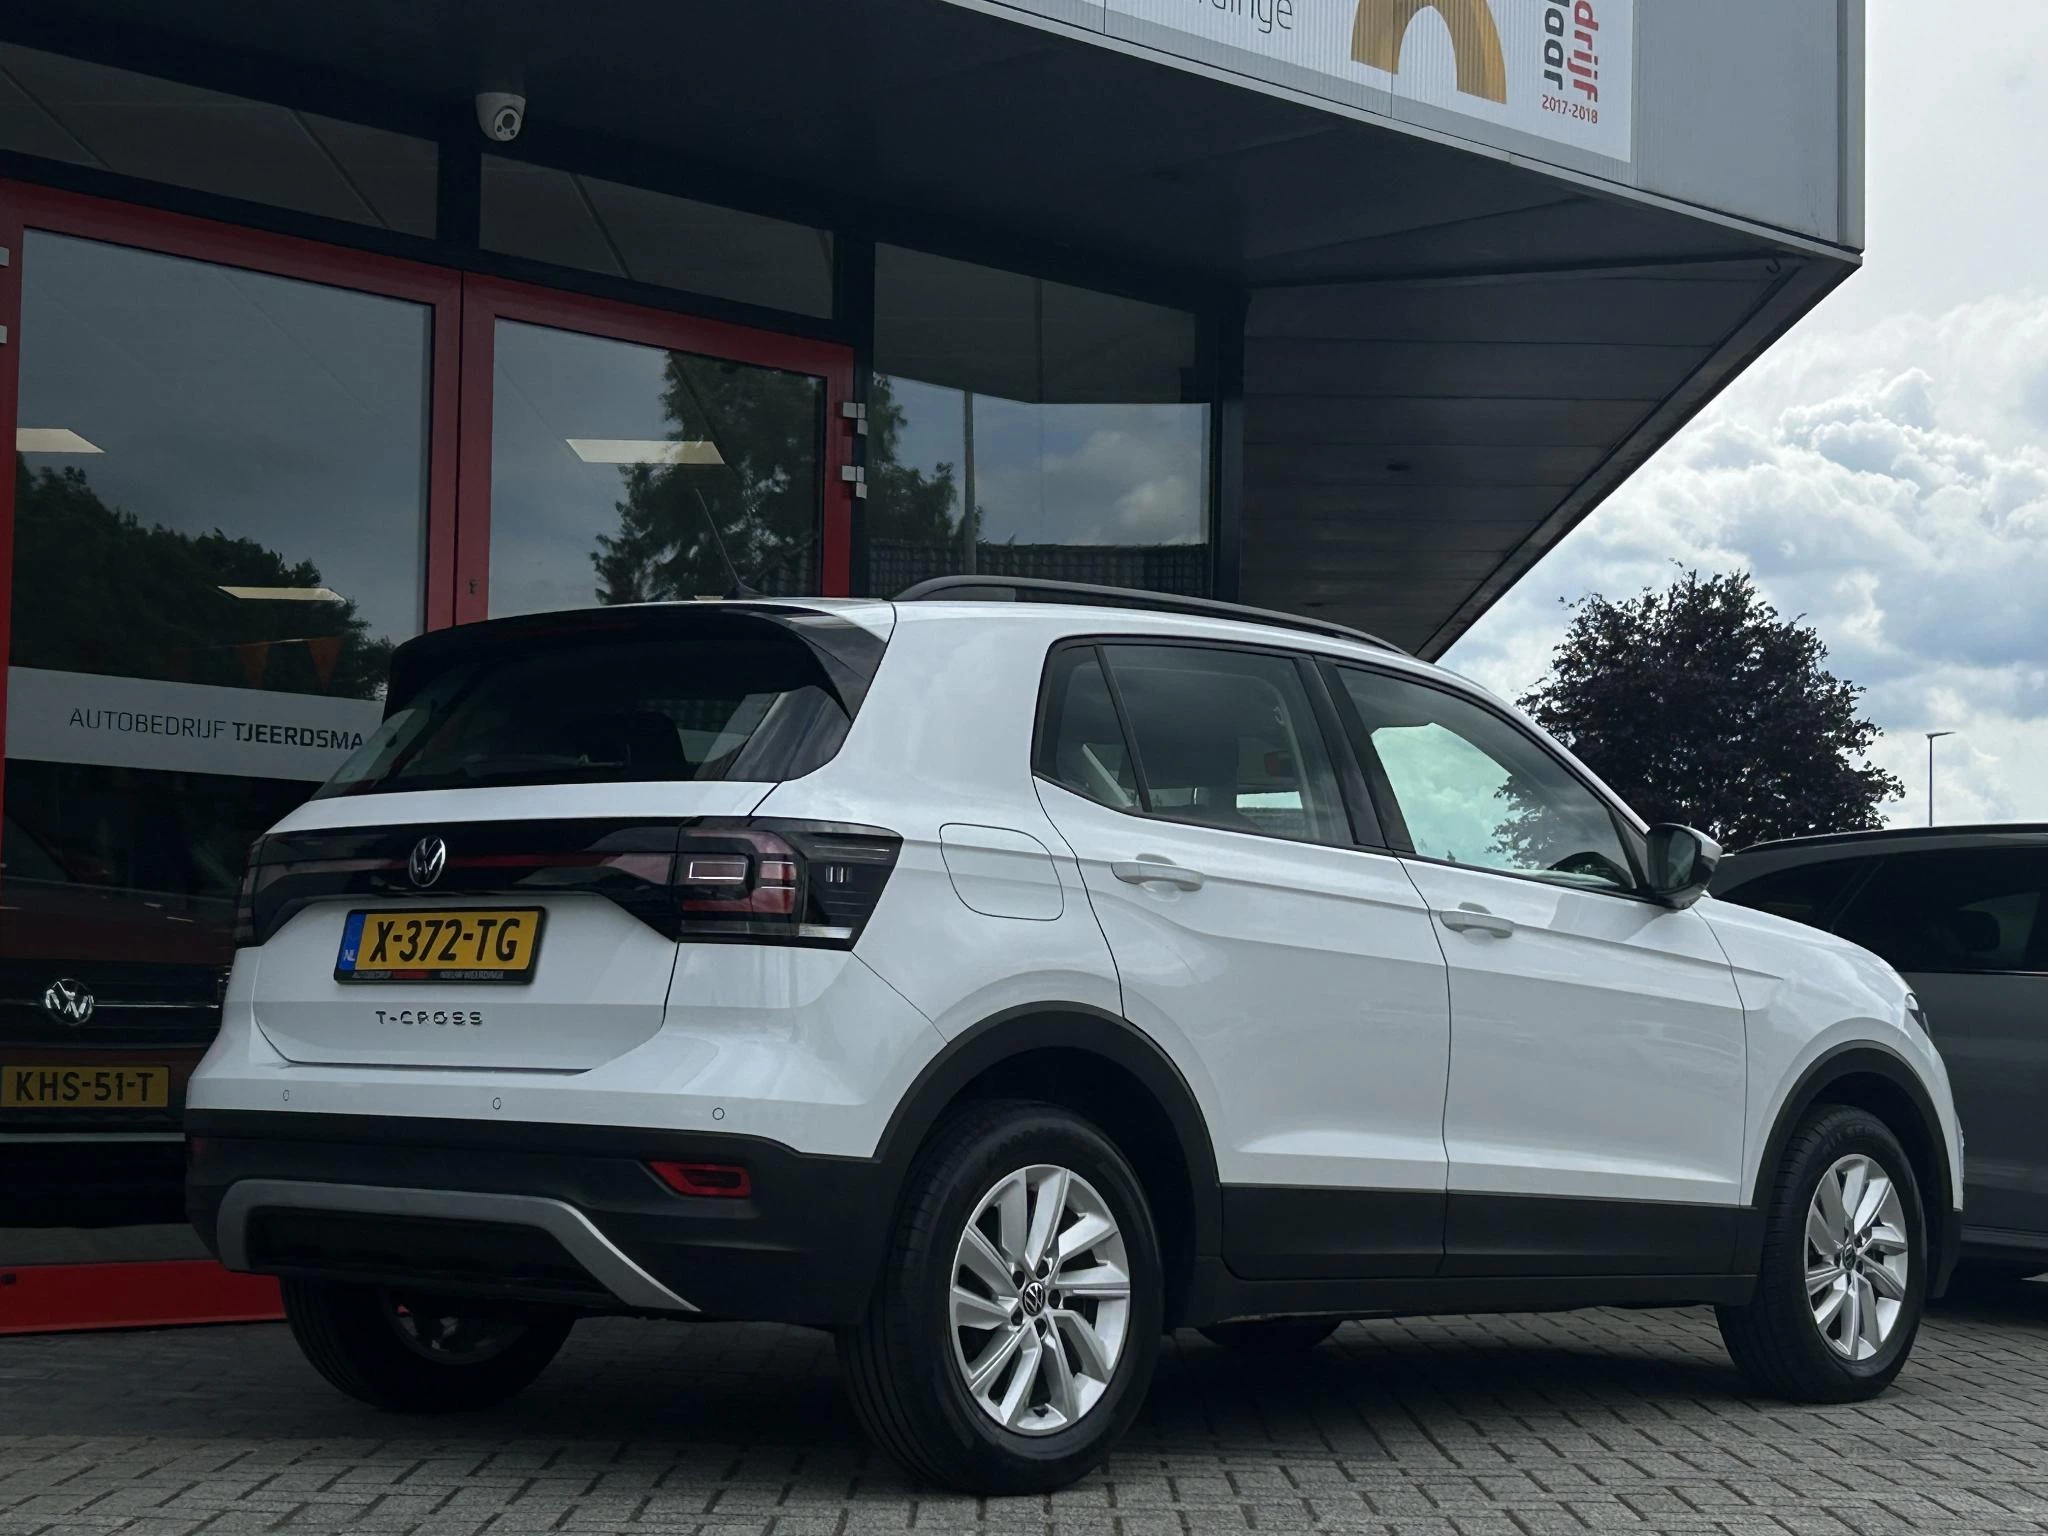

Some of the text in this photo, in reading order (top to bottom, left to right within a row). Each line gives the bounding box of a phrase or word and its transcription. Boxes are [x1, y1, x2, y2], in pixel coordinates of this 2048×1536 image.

[1543, 0, 1570, 91] aar
[69, 706, 364, 751] AUTOBEDRIJF TJEERDSMA
[368, 918, 521, 962] X-372-TG
[375, 1010, 483, 1026] T-CROSS
[15, 1071, 154, 1101] KHS-51-T
